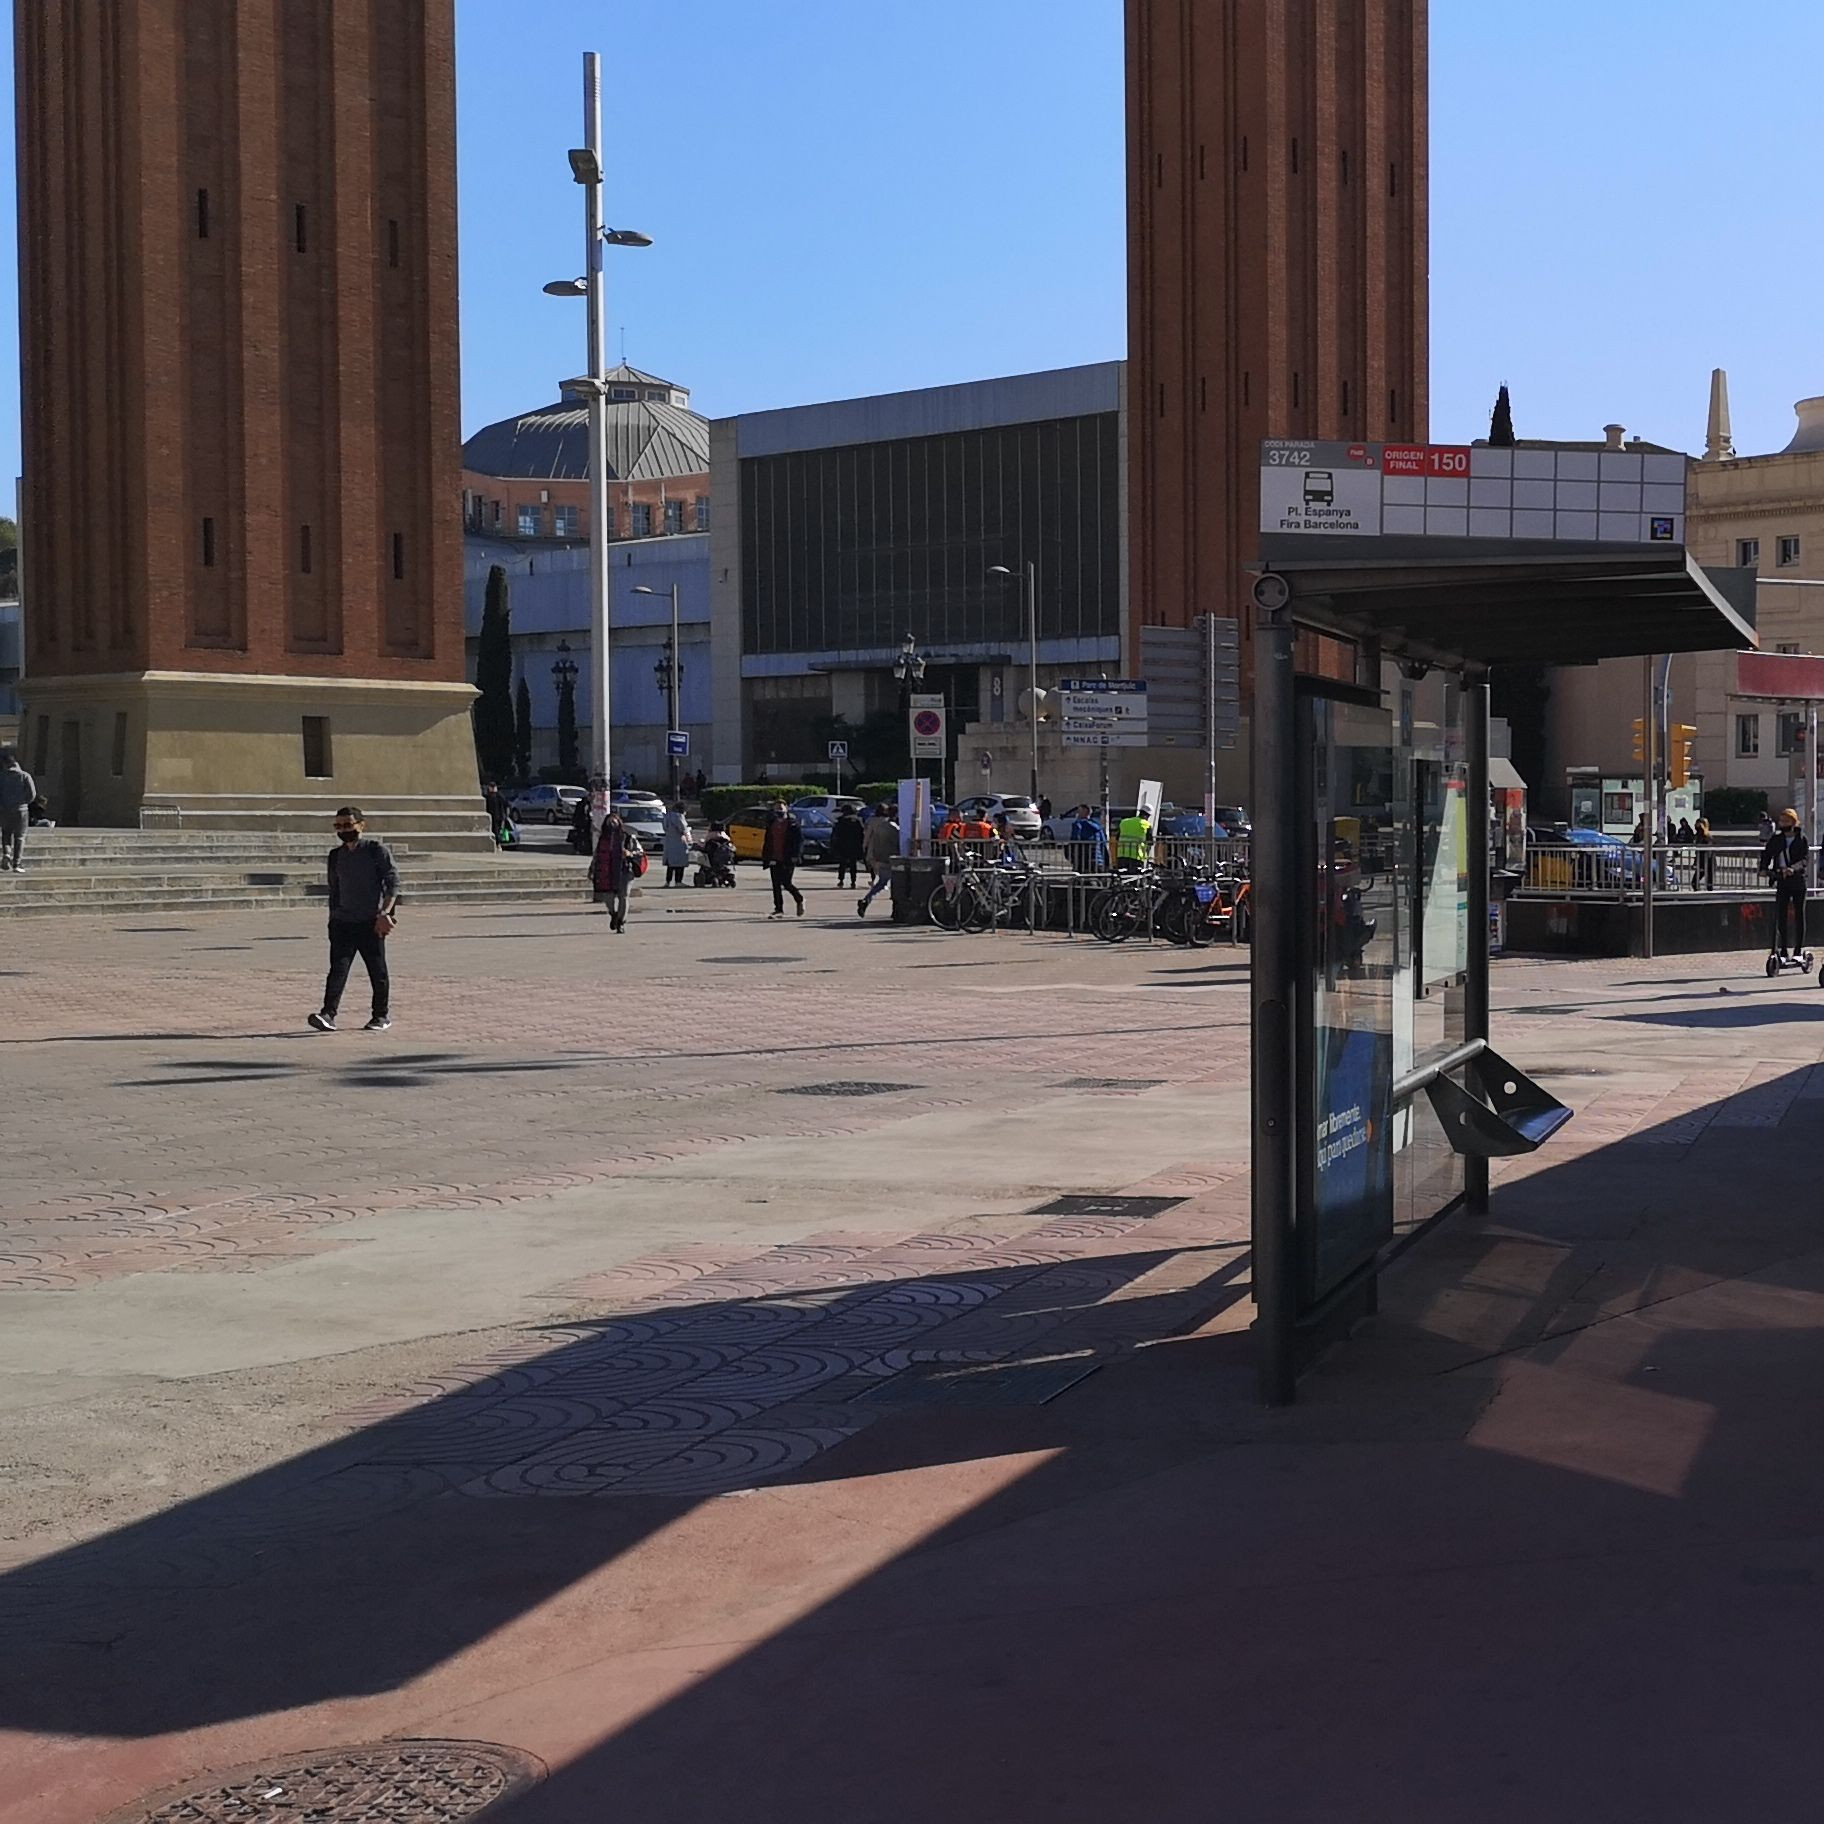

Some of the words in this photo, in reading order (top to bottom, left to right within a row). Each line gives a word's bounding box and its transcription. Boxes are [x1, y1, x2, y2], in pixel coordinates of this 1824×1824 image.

[1284, 440, 1316, 449] PARADA
[1269, 450, 1311, 465] 3742
[1385, 450, 1424, 460] ORIGEN
[1389, 461, 1419, 470] FINAL
[1430, 453, 1467, 471] 150
[1287, 507, 1301, 517] Pl.
[1304, 507, 1351, 519] Espanya
[1280, 519, 1300, 530] Fira
[1304, 520, 1359, 530] Barcelona
[993, 677, 1001, 696] 8
